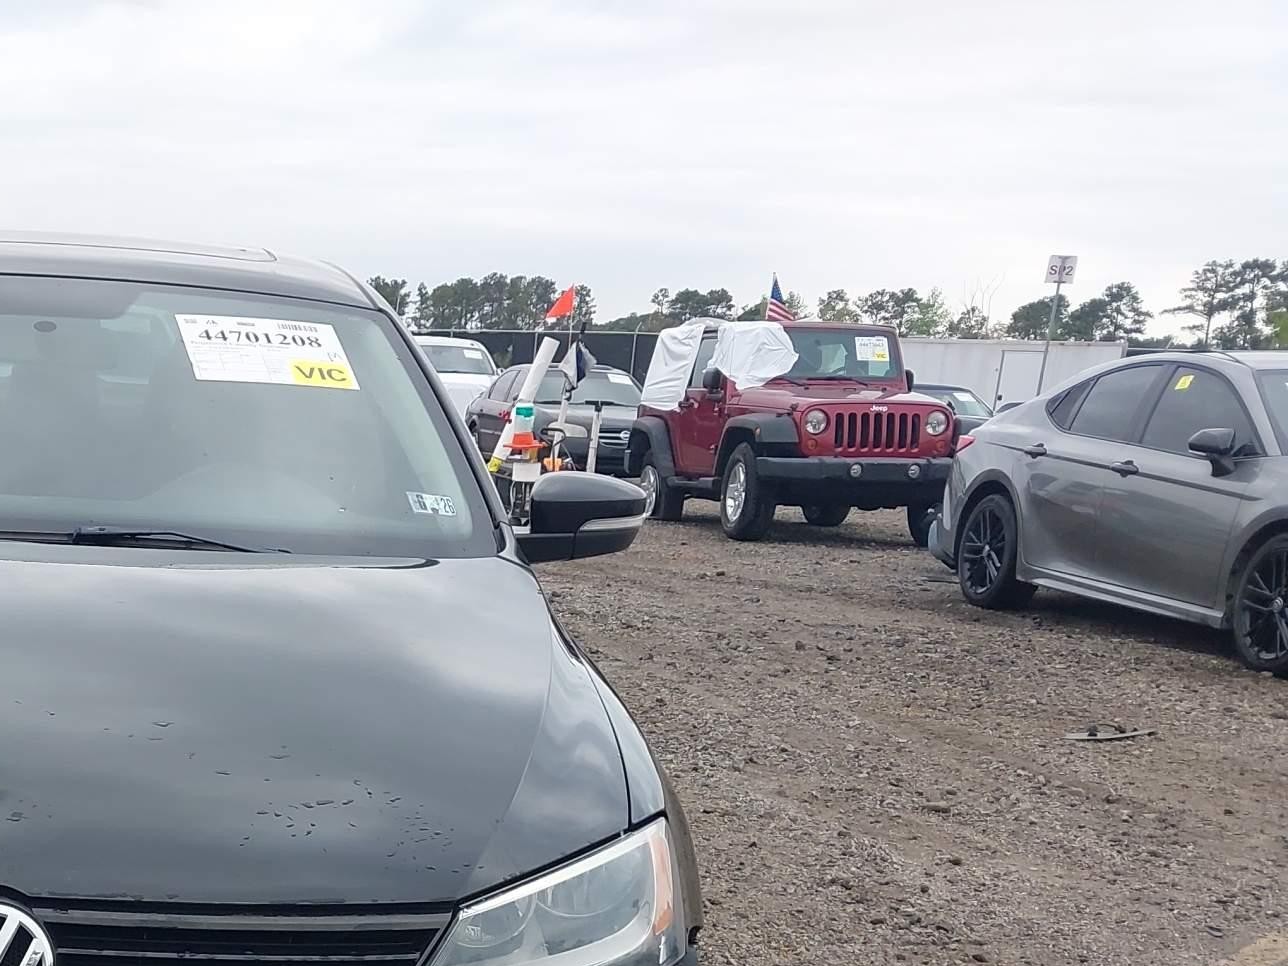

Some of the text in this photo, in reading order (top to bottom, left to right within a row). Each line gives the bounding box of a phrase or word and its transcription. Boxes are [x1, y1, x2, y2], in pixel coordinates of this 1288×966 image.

[198, 328, 322, 348] 44701208
[294, 365, 348, 382] VIC
[440, 497, 456, 514] 26
